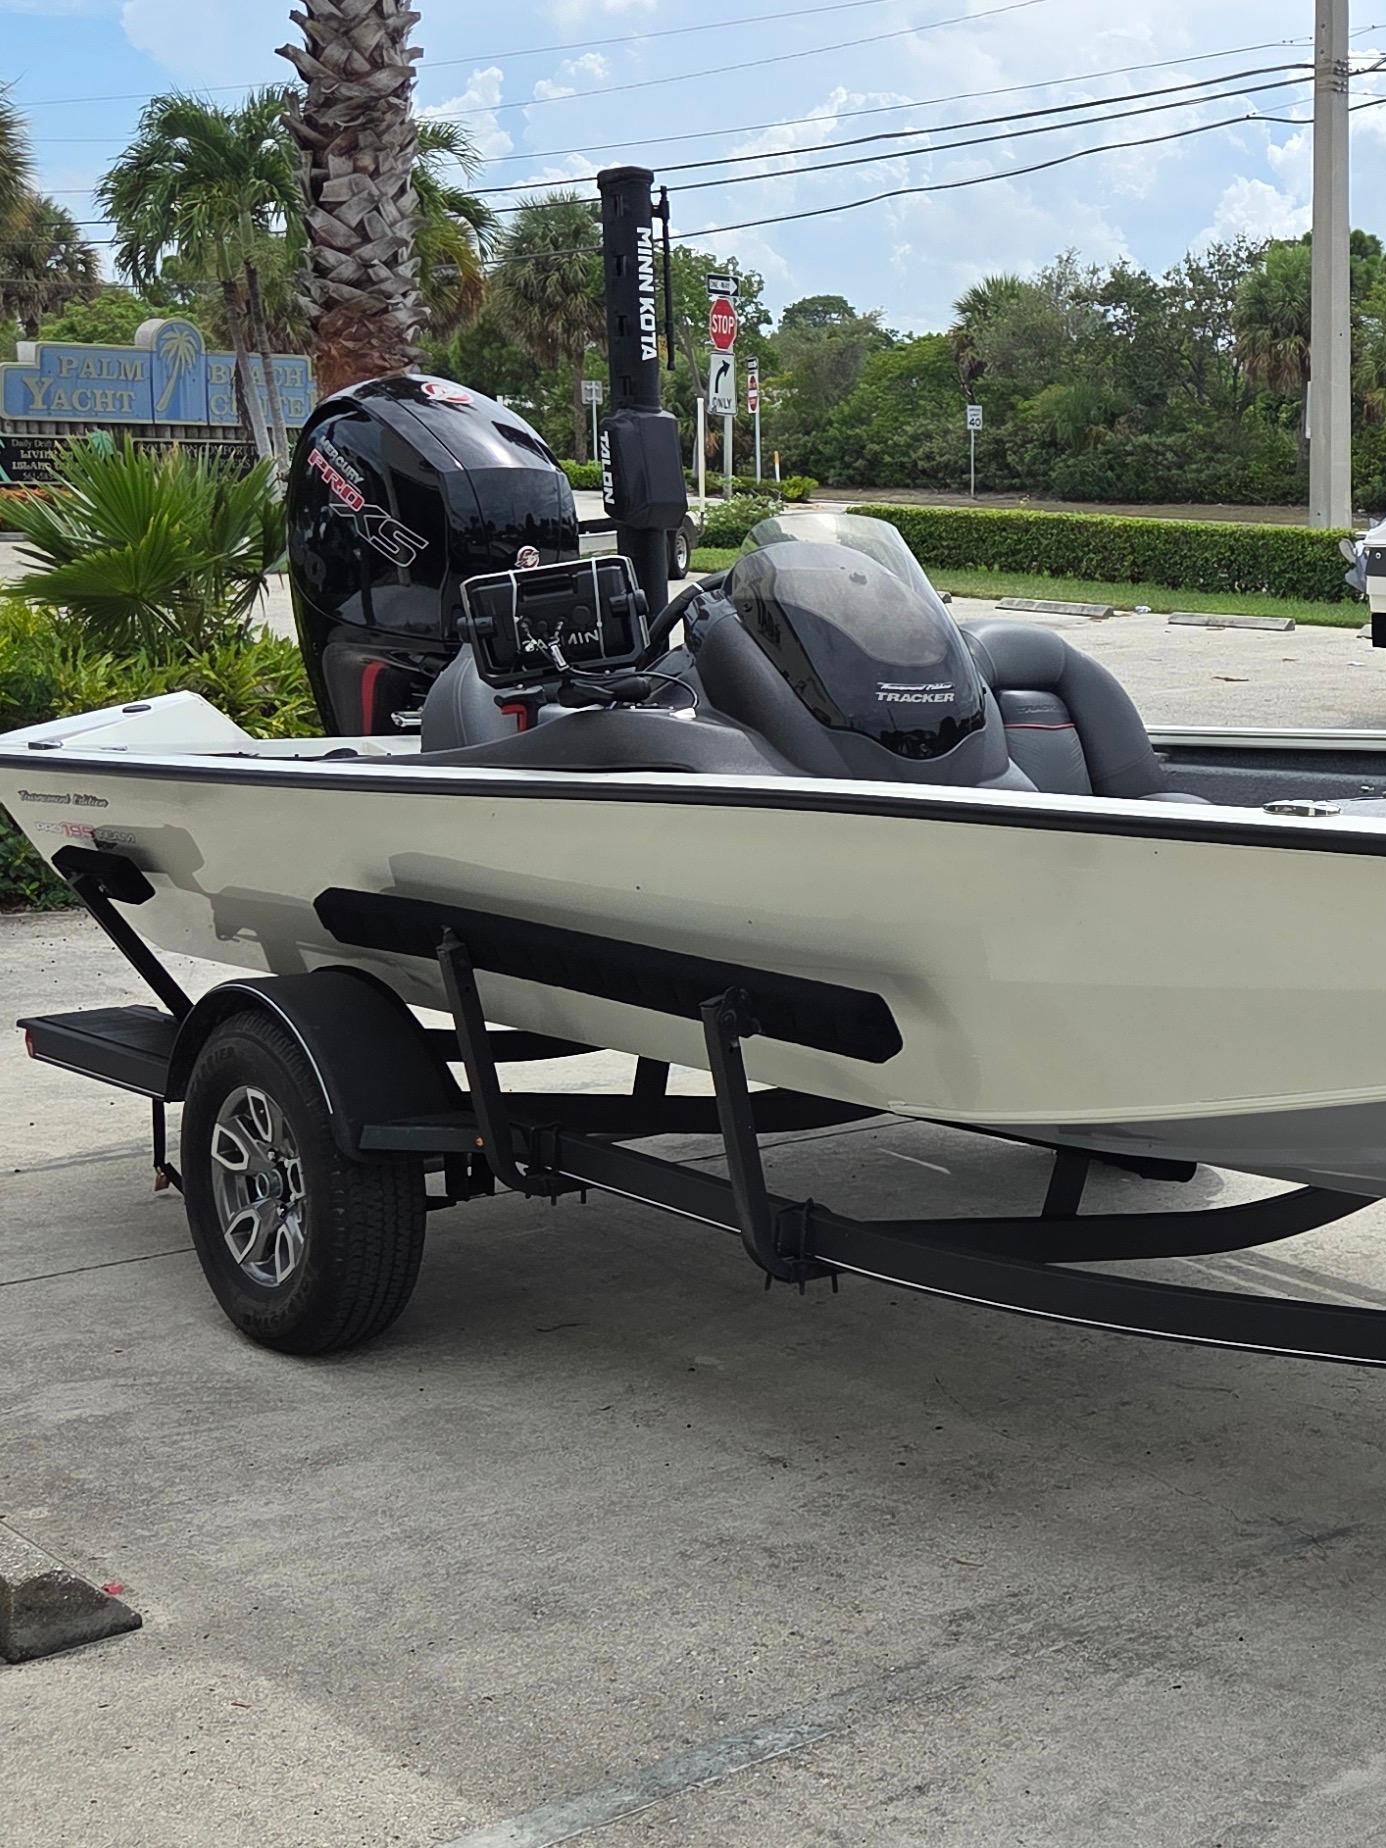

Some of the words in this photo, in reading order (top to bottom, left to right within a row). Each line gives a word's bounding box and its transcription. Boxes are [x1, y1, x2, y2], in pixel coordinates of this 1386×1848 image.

[636, 226, 655, 292] MINN
[639, 297, 658, 361] KOTA
[711, 314, 735, 334] STOP
[59, 355, 145, 381] PALM
[22, 375, 136, 413] YACHT
[710, 396, 733, 410] ONLY
[969, 417, 981, 427] 40
[307, 448, 365, 512] PRO
[320, 435, 365, 484] MERCURY
[600, 430, 615, 505] TALON
[329, 503, 429, 567] XS
[875, 691, 955, 703] TRACKER
